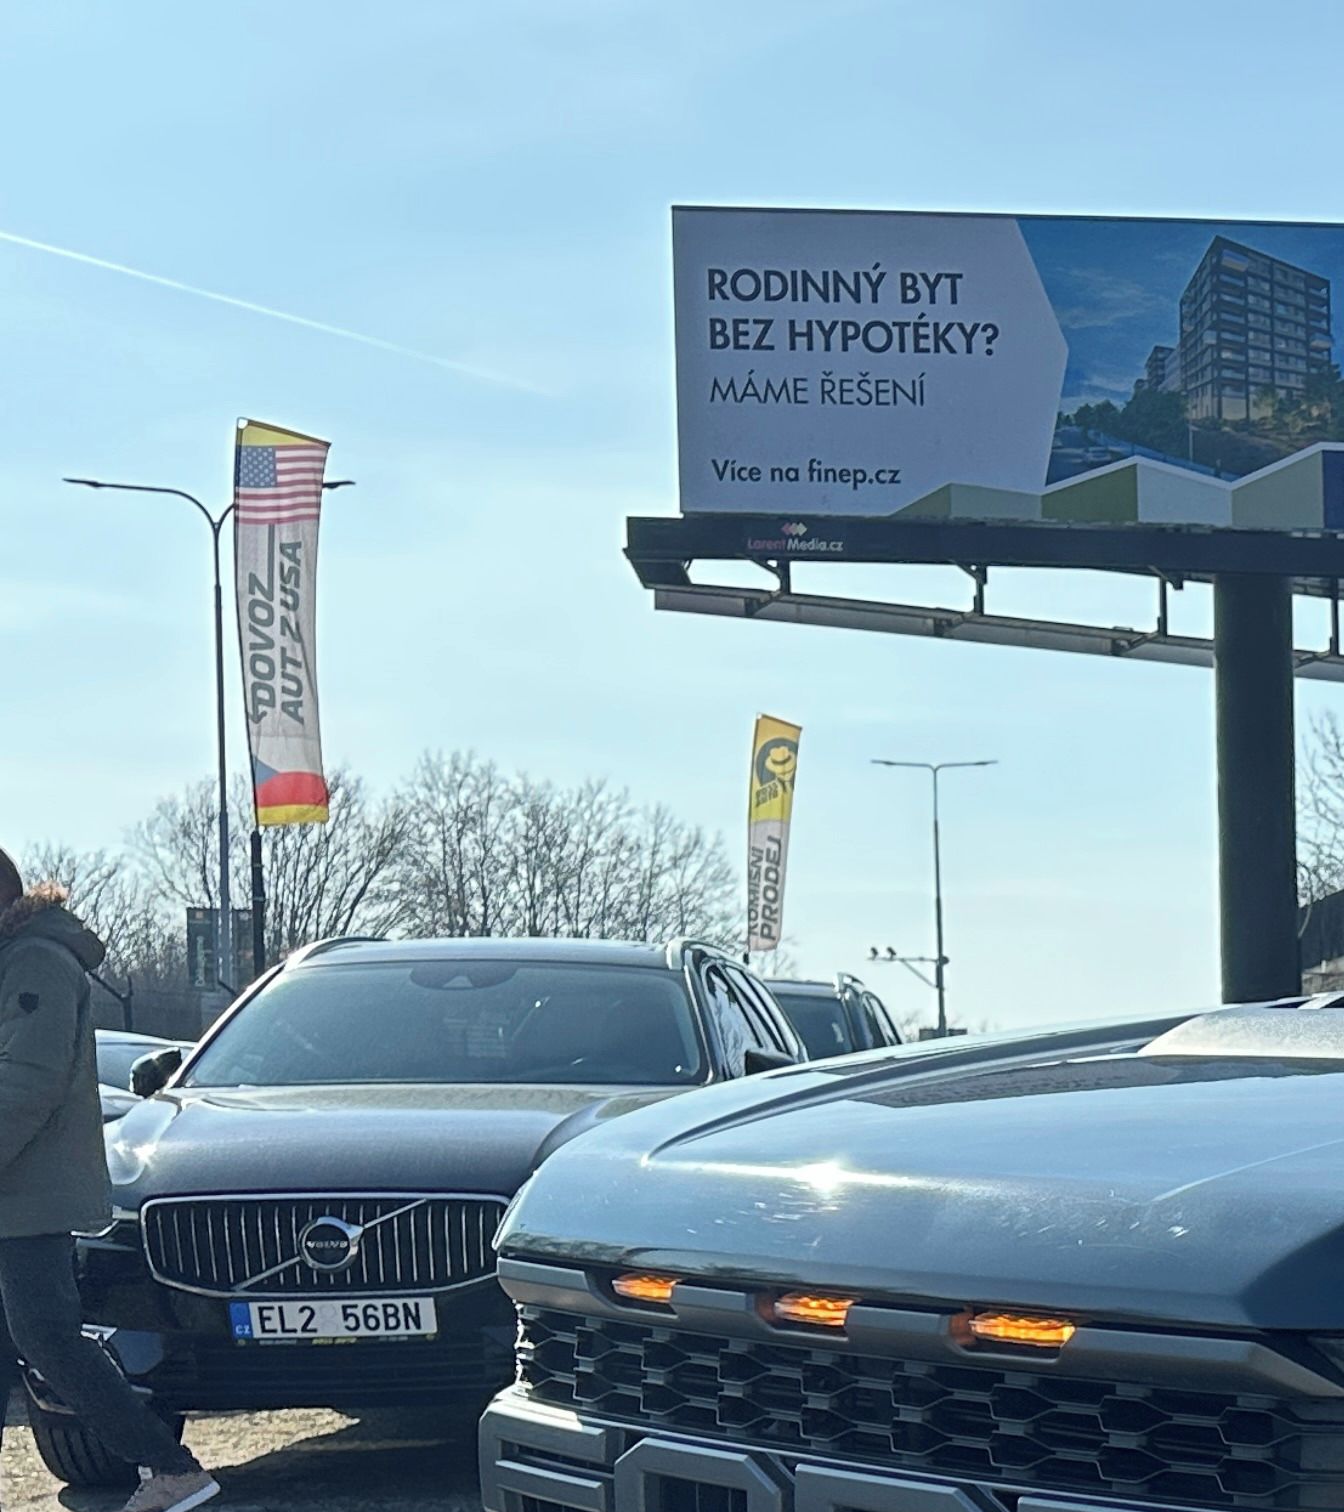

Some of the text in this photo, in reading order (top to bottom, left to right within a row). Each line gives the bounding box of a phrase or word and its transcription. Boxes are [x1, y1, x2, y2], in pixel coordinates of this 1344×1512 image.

[707, 262, 963, 305] RODINNÝ BYT
[709, 312, 1000, 356] BEZ HYPOTÉKY?
[709, 369, 926, 407] MÁME ŘEŠENÍ
[711, 458, 901, 490] Více na finep.cz
[248, 571, 276, 718] DOVOZ
[279, 541, 304, 726] AUT Z USA
[760, 835, 782, 941] PRODEJ
[235, 1325, 249, 1335] CZ
[257, 1302, 421, 1334] EL2 56BN
